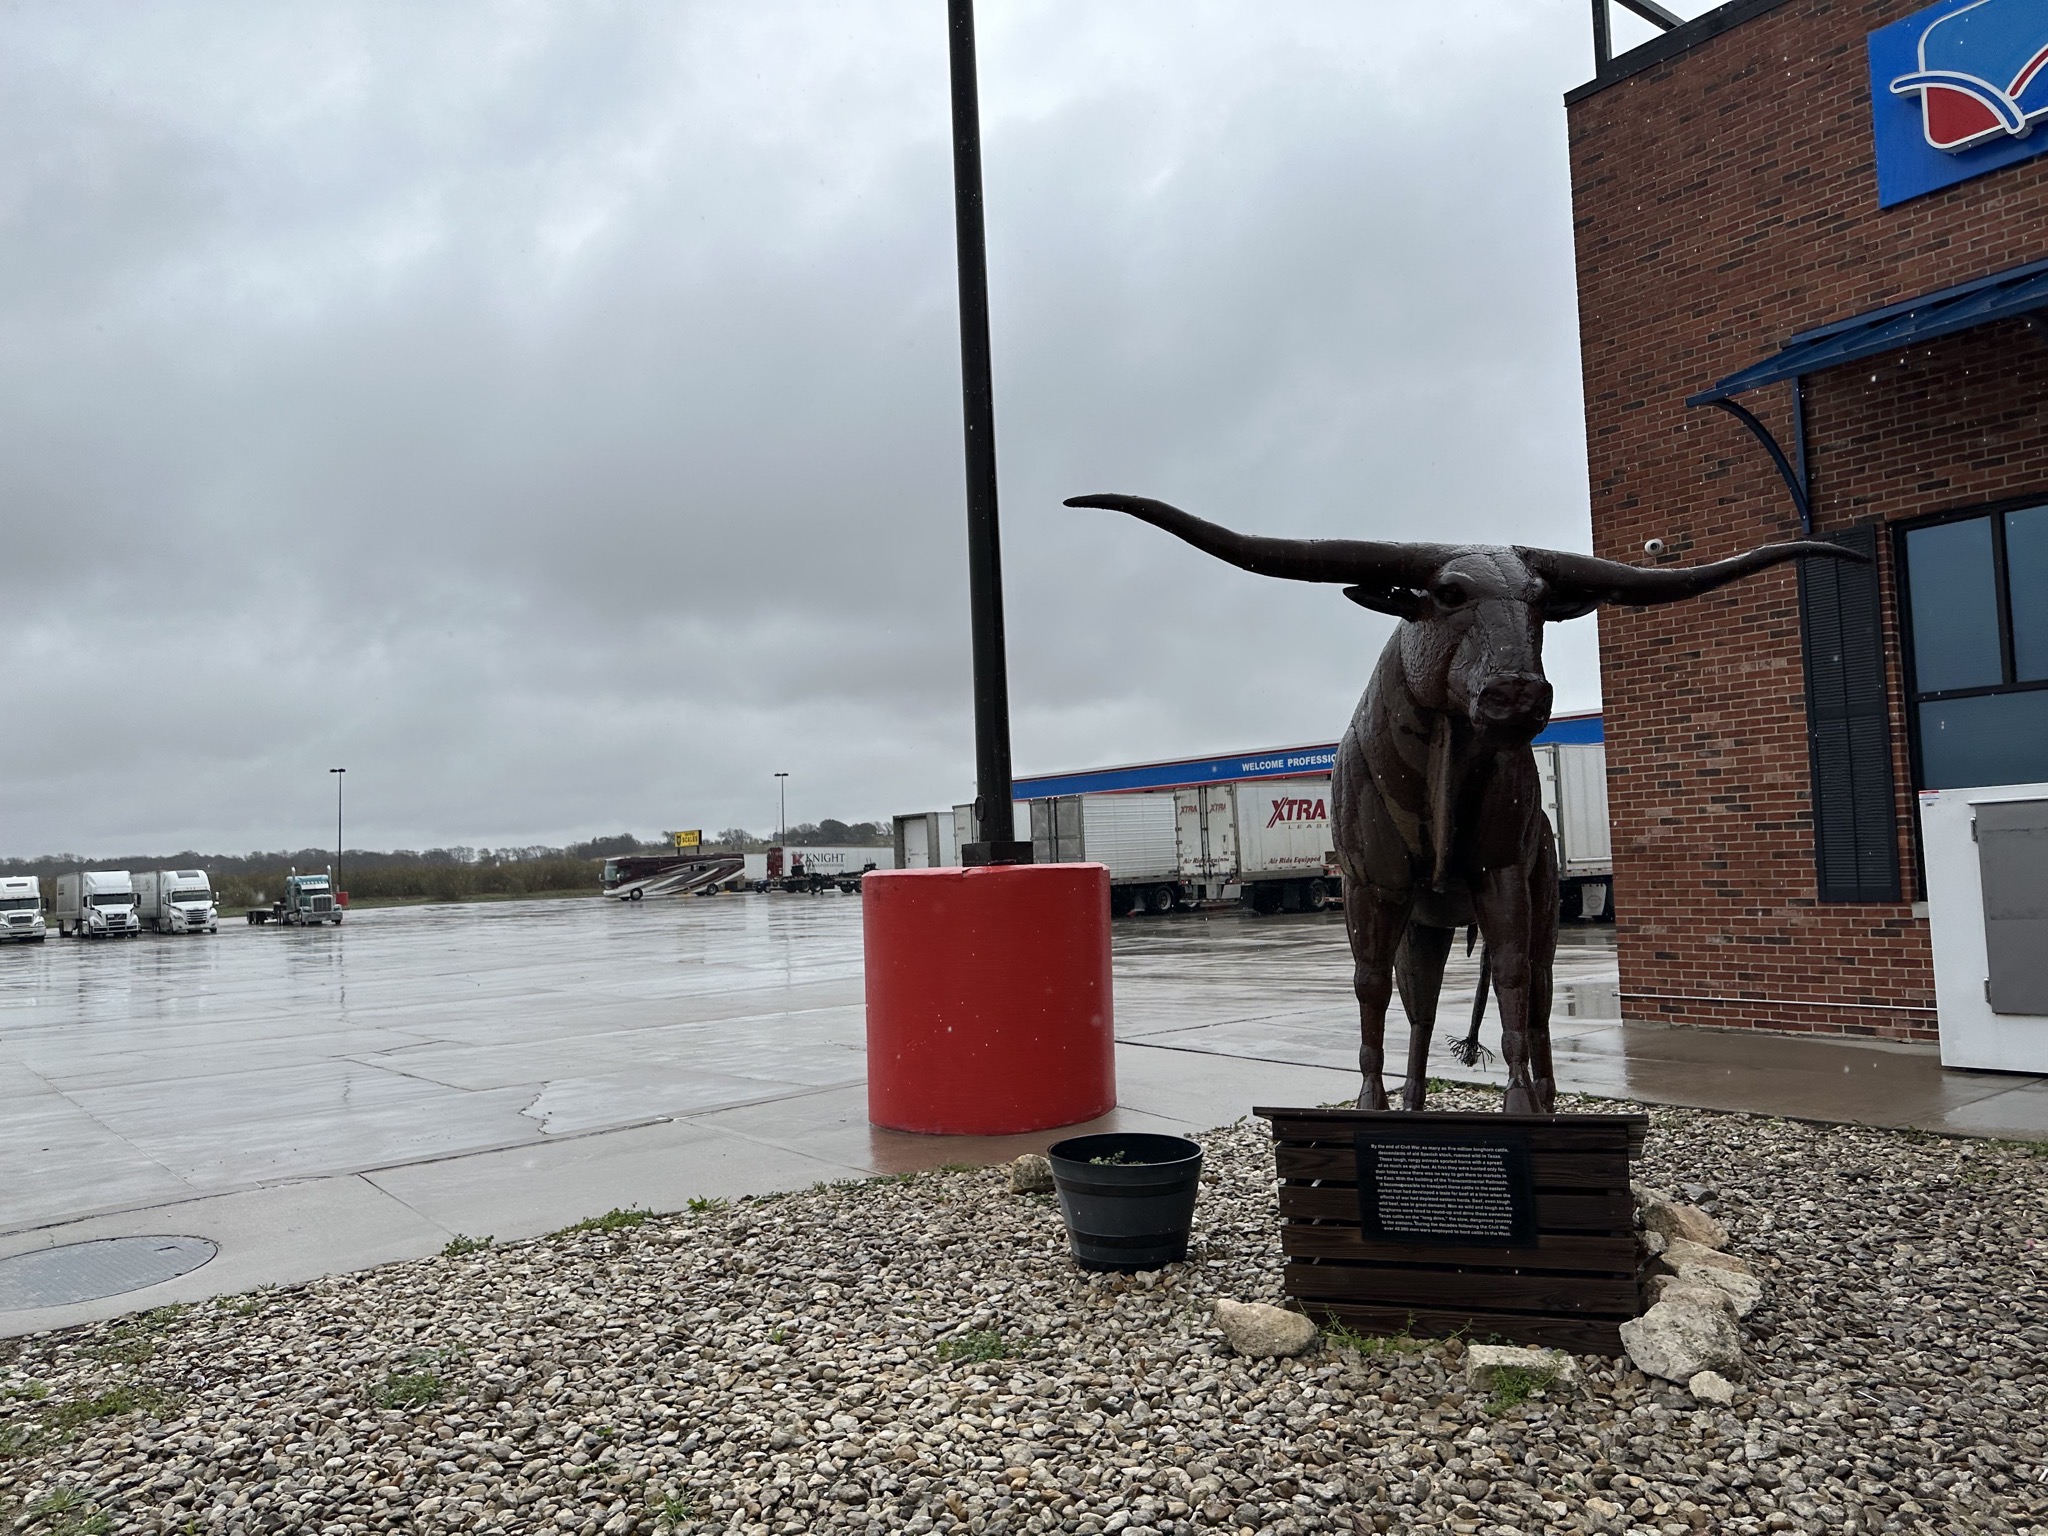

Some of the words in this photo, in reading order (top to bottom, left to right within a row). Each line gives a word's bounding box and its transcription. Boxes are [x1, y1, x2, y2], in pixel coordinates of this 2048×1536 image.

[1242, 760, 1284, 771] WELCOME
[1288, 754, 1336, 767] PROFESSIO
[1180, 805, 1198, 815] XTRA
[1266, 797, 1326, 828] XTRA
[806, 853, 845, 862] KNIGHT
